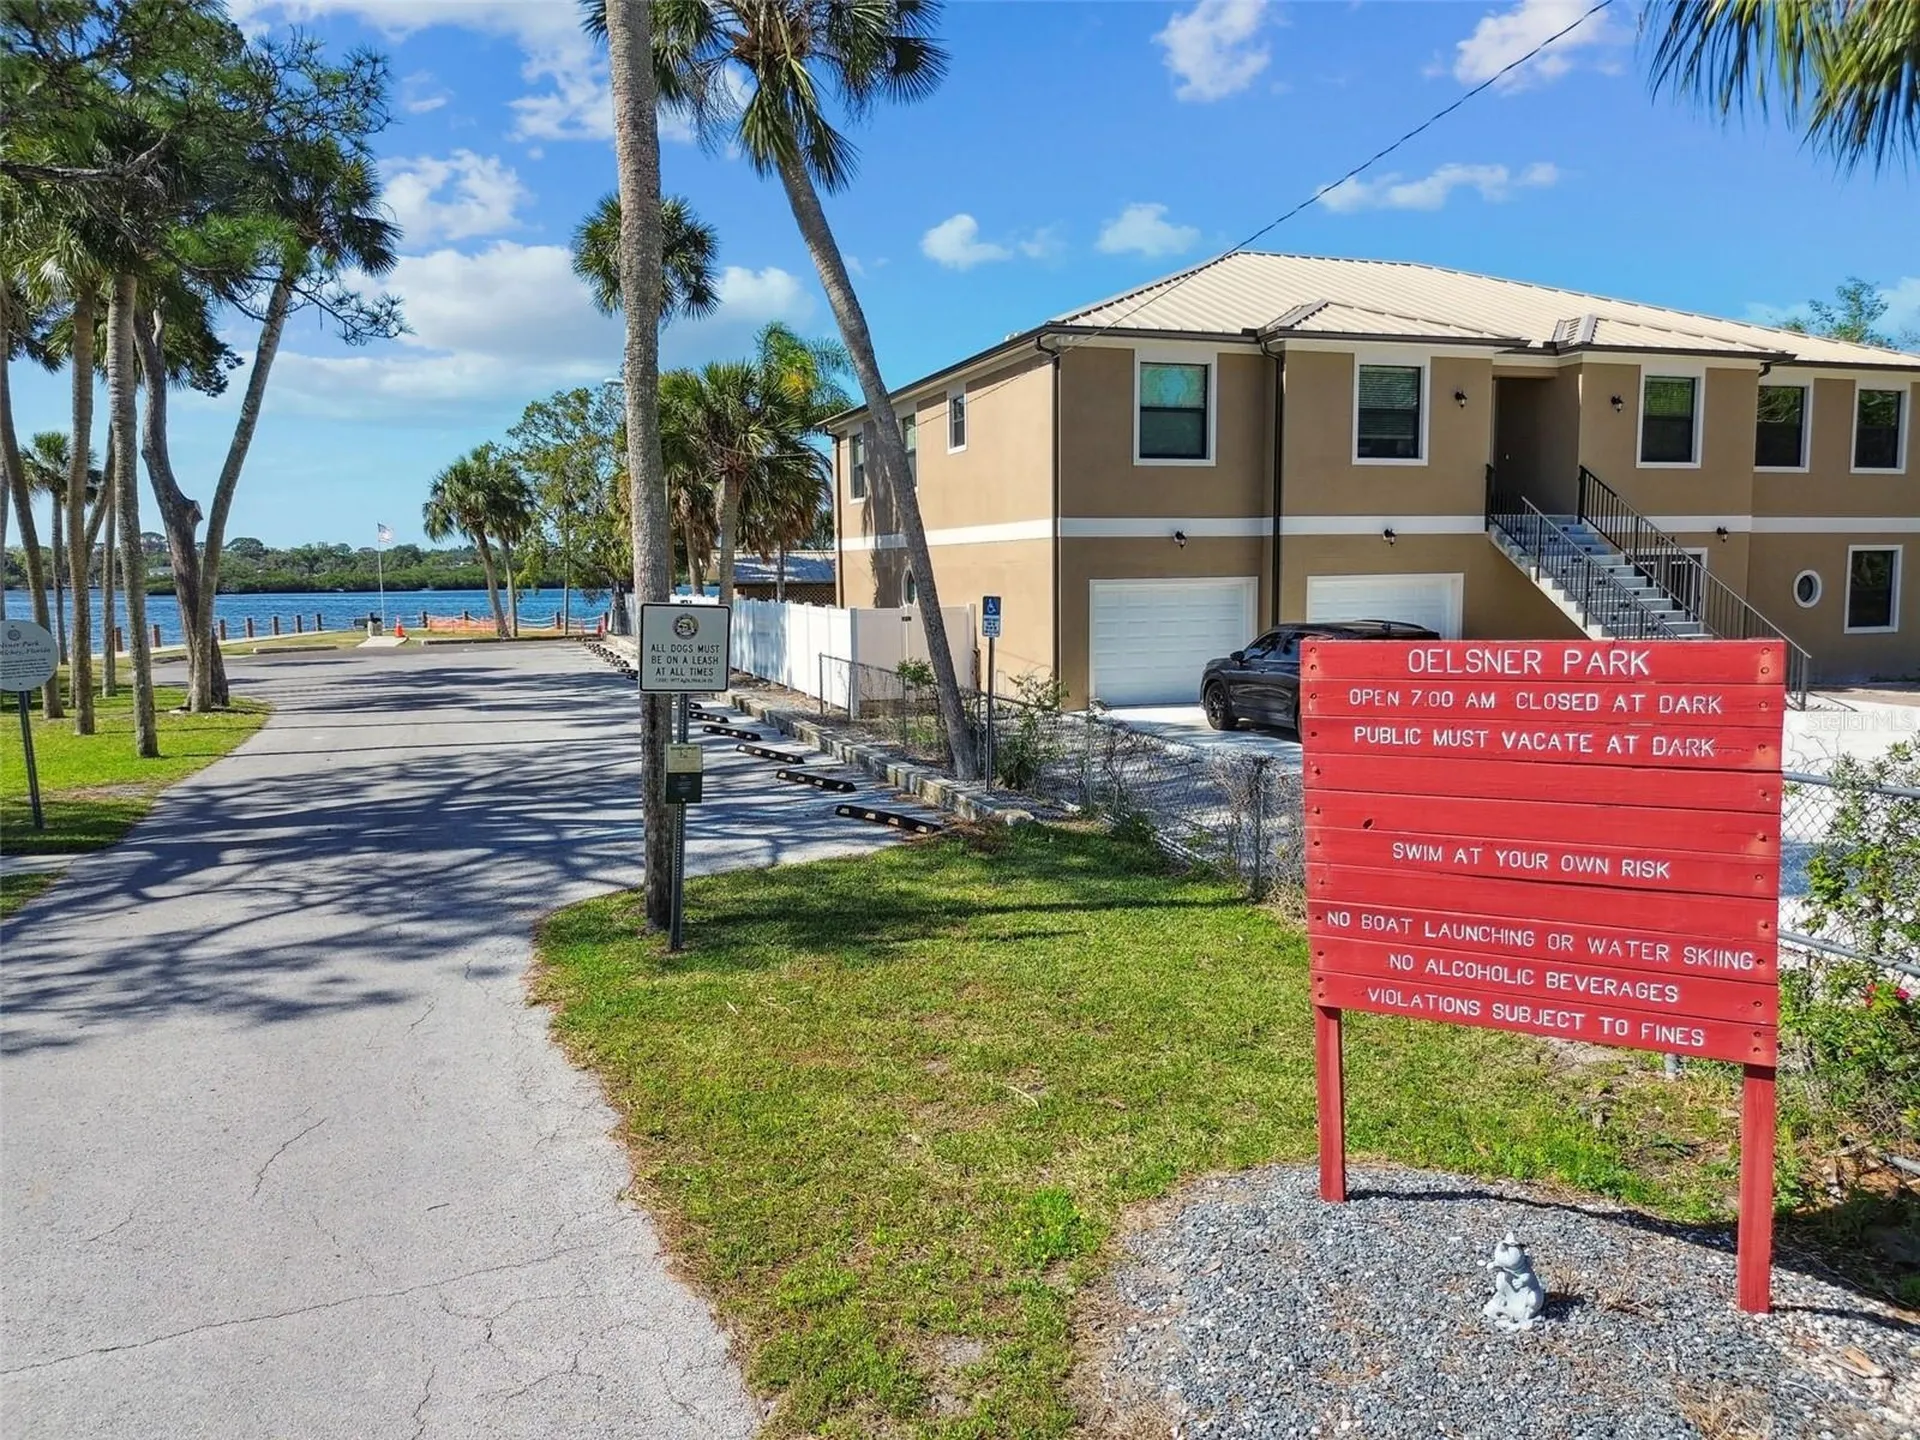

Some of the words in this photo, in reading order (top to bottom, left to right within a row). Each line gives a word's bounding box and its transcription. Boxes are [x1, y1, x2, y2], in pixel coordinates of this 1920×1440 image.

[651, 644, 666, 652] ALL
[671, 644, 693, 653] DOGS
[698, 645, 720, 653] MUST
[651, 656, 662, 664] BE
[667, 656, 677, 664] ON
[683, 656, 688, 664] A
[692, 656, 718, 665] LEASH
[1408, 648, 1543, 675] OELSNER
[1563, 649, 1650, 676] PARK
[656, 667, 665, 675] AT
[670, 668, 684, 676] ALL
[690, 668, 714, 676] TIMES
[1349, 688, 1400, 707] OPEN
[1465, 691, 1496, 709] AM
[1516, 692, 1600, 711] CLOSED
[1612, 694, 1647, 713] AT
[1659, 695, 1723, 715] DARK
[1353, 726, 1422, 746] PUBLIC
[1432, 729, 1489, 749] MUST
[1501, 732, 1593, 753] VACATE
[1606, 735, 1640, 755] AT
[1652, 736, 1716, 758] DARK
[1392, 842, 1443, 863] SWIM
[1453, 847, 1483, 865] AT
[1495, 849, 1549, 870] YOUR
[1560, 855, 1610, 875] OWN
[1621, 859, 1671, 880] RISK
[1326, 911, 1351, 927] NO
[1361, 913, 1413, 934] BOAT
[1424, 920, 1535, 946] LAUNCHING
[1547, 933, 1574, 952] OR
[1587, 937, 1670, 963] WATER
[1683, 946, 1755, 971] SKIING
[1388, 953, 1414, 971] NO
[1424, 958, 1535, 986] ALCOHOLIC
[1545, 971, 1680, 1003] BEVERAGES
[1367, 987, 1481, 1017] VIOLATIONS
[1492, 1002, 1586, 1031] SUBJECT
[1598, 1016, 1629, 1037] TO
[1641, 1022, 1705, 1047] FINES
